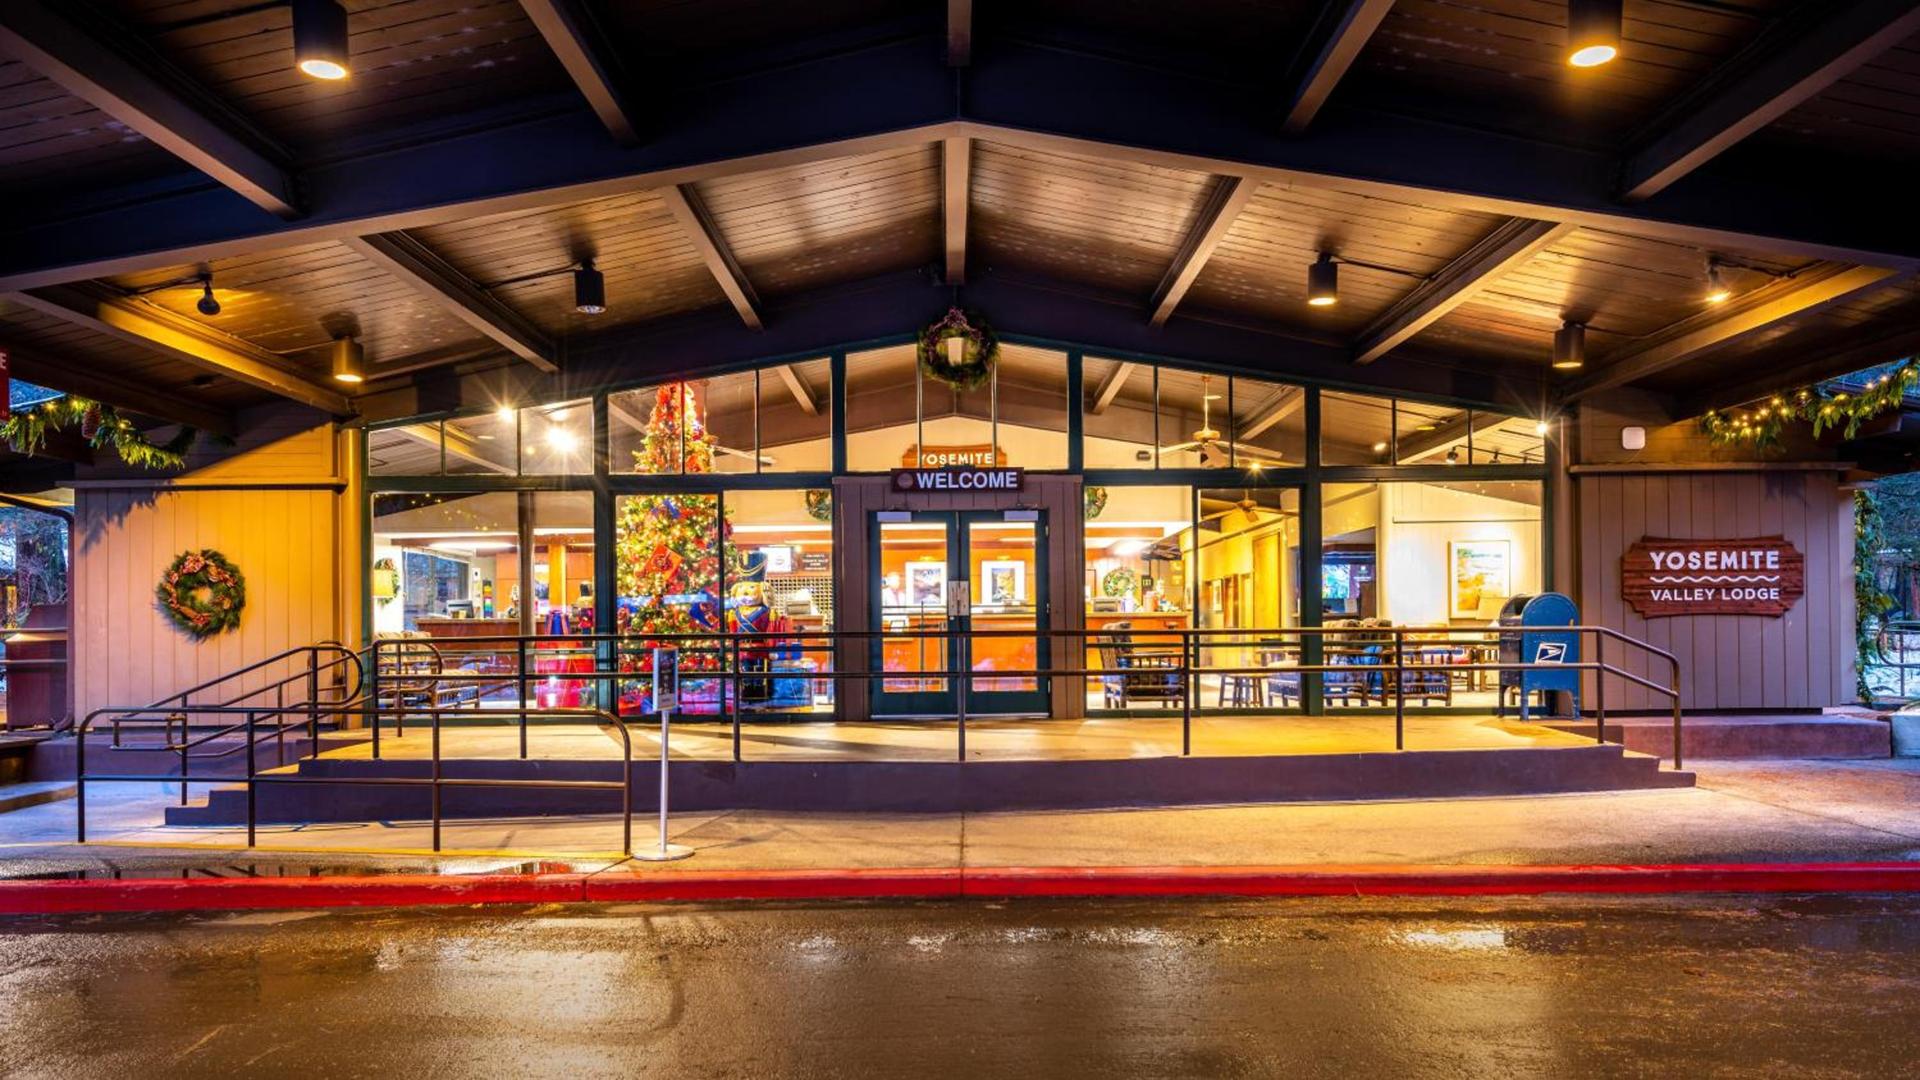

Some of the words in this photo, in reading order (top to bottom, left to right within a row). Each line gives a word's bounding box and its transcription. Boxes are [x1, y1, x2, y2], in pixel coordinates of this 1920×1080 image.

[916, 471, 1018, 489] WELCOME
[1649, 550, 1780, 570] YOSEMITE
[1650, 588, 1716, 601] VALLEY
[1721, 587, 1780, 601] LODGE
